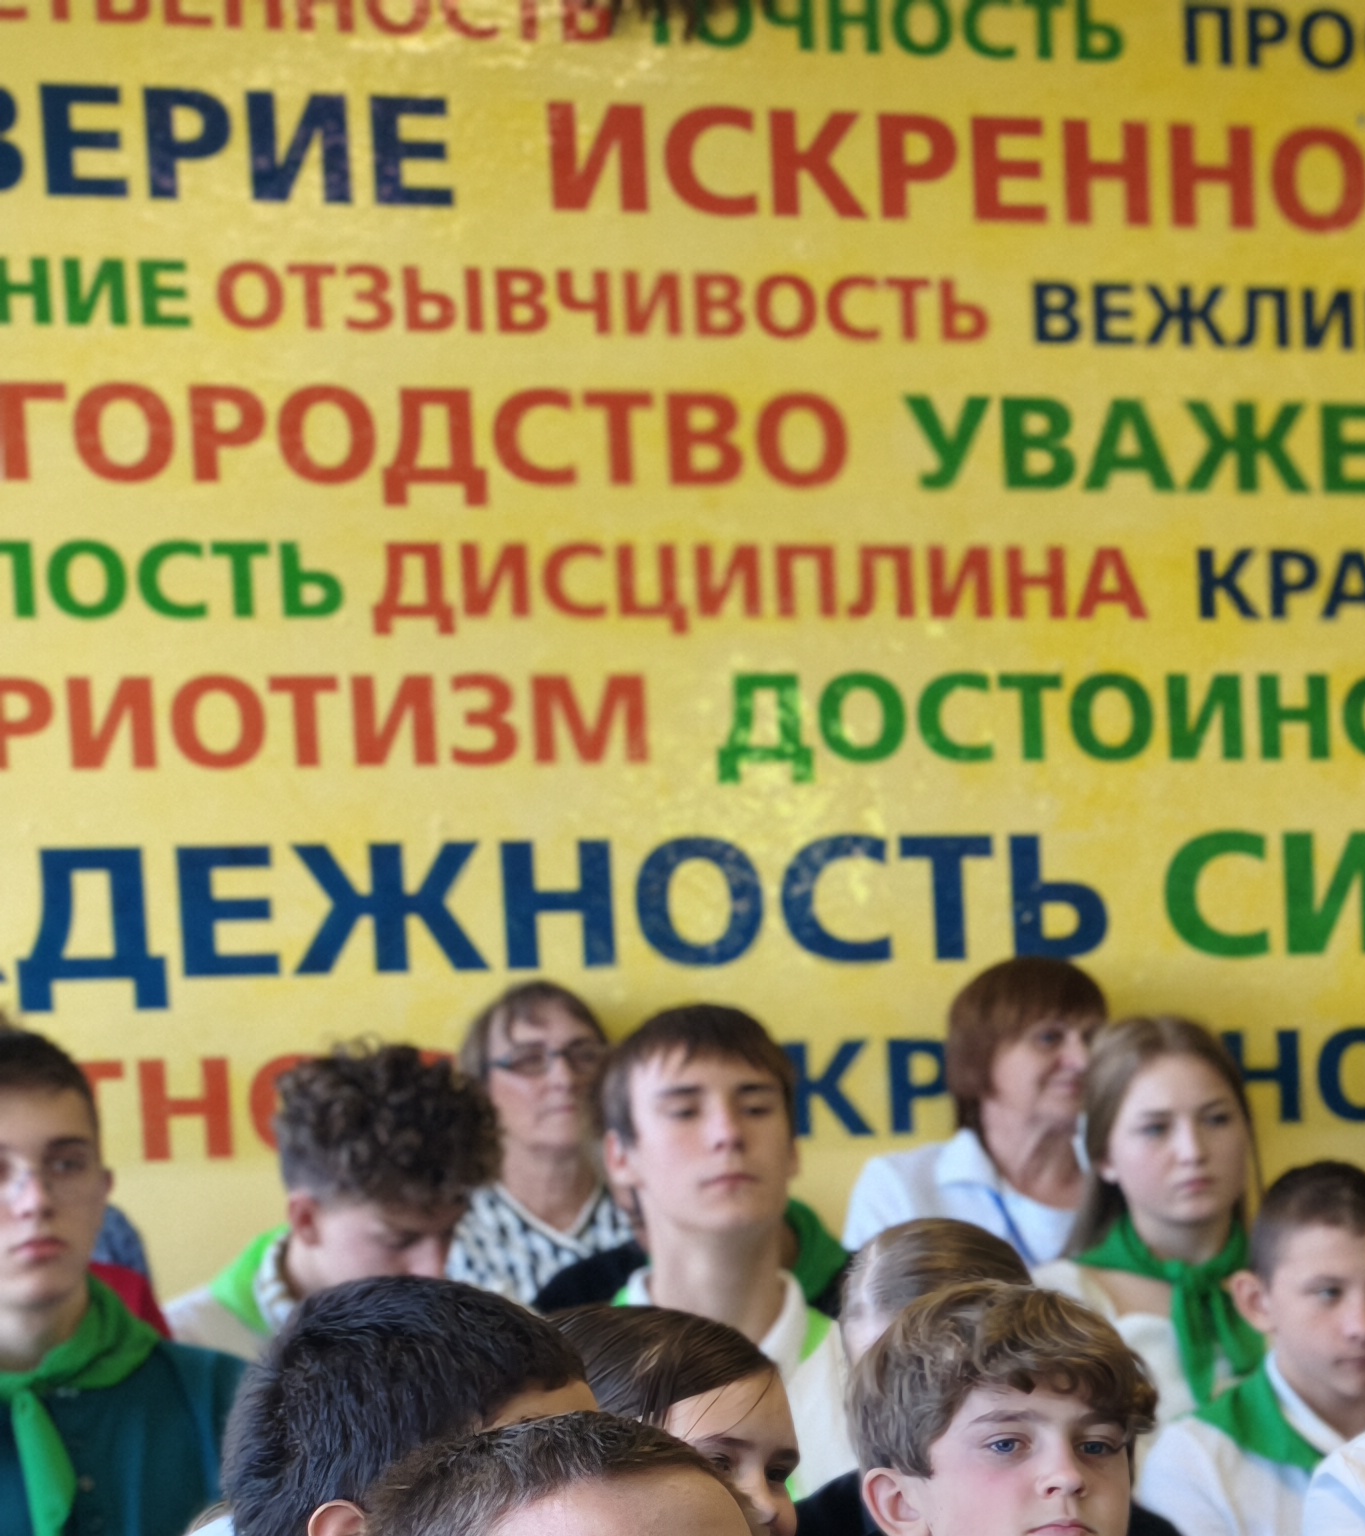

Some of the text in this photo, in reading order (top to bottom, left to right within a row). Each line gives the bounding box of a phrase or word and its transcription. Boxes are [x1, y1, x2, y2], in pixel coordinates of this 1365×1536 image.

[0, 259, 189, 327] НИЕ
[219, 263, 987, 340] ОТЗЫВЧИВОСТЬ
[0, 384, 846, 506] ГОРОДСТВО
[375, 545, 1145, 635] ДИСЦИПЛИНА
[0, 675, 646, 769] РИОТИЗМ
[0, 834, 1110, 1013] ДЕЖНОСТЬ
